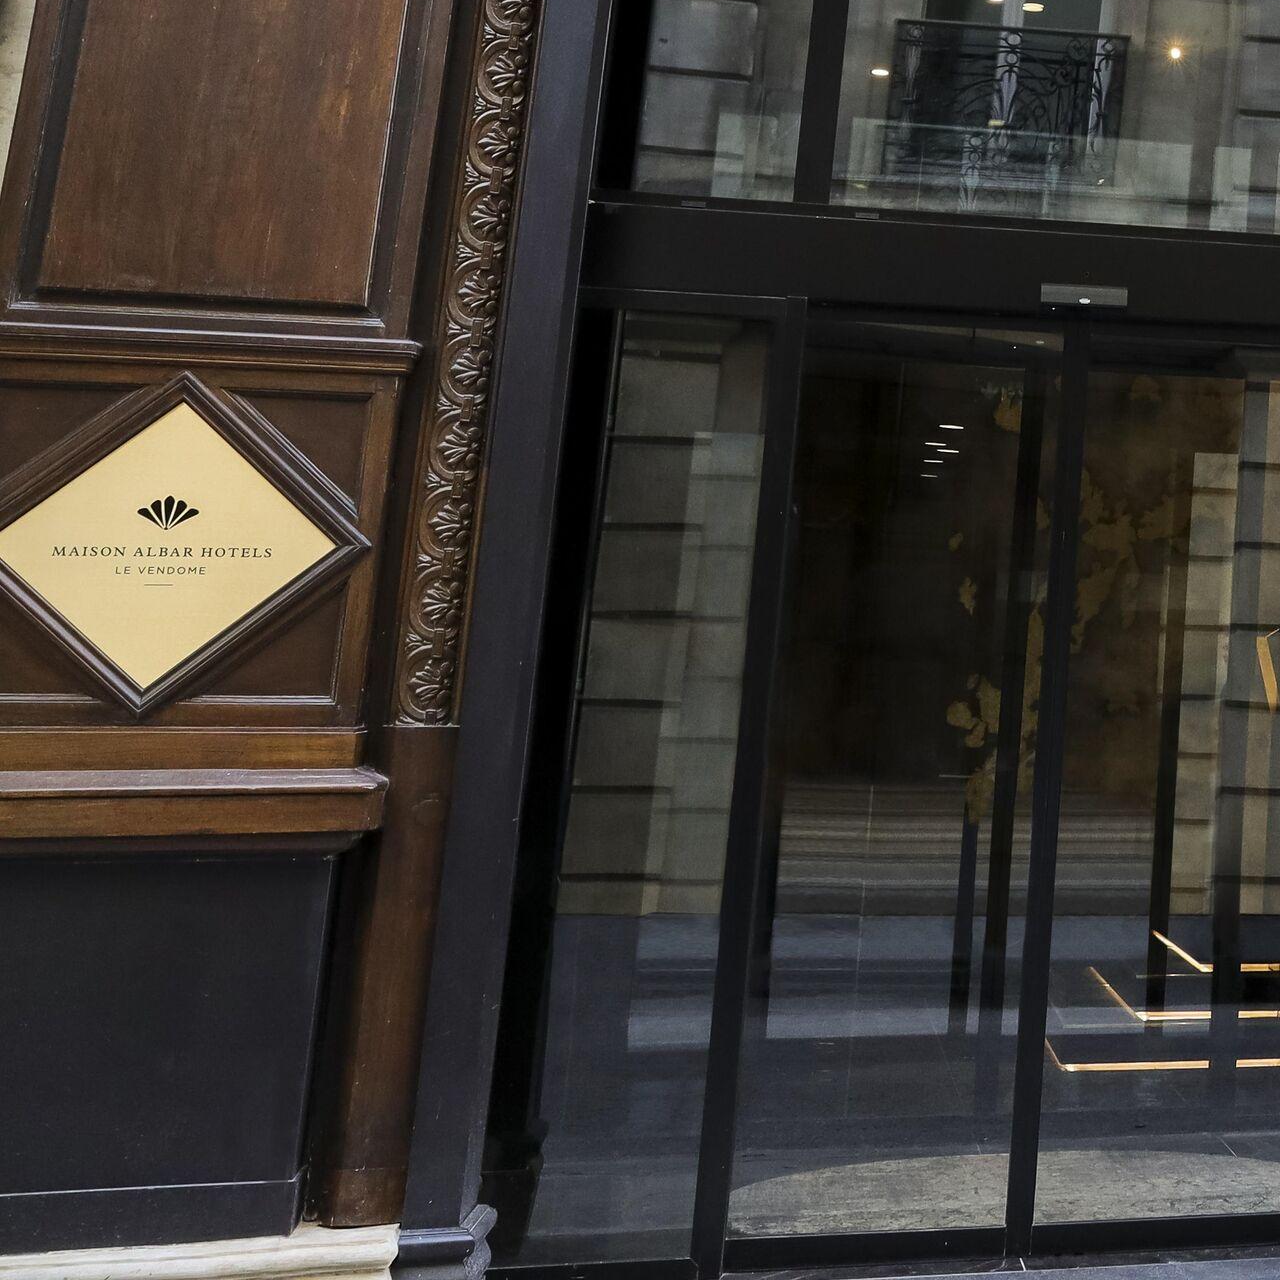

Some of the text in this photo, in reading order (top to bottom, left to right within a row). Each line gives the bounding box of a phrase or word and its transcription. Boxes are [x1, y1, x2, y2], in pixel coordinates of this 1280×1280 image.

[51, 545, 273, 559] MAISON ALBAR HOTELS
[115, 566, 206, 576] LE VENDOME
